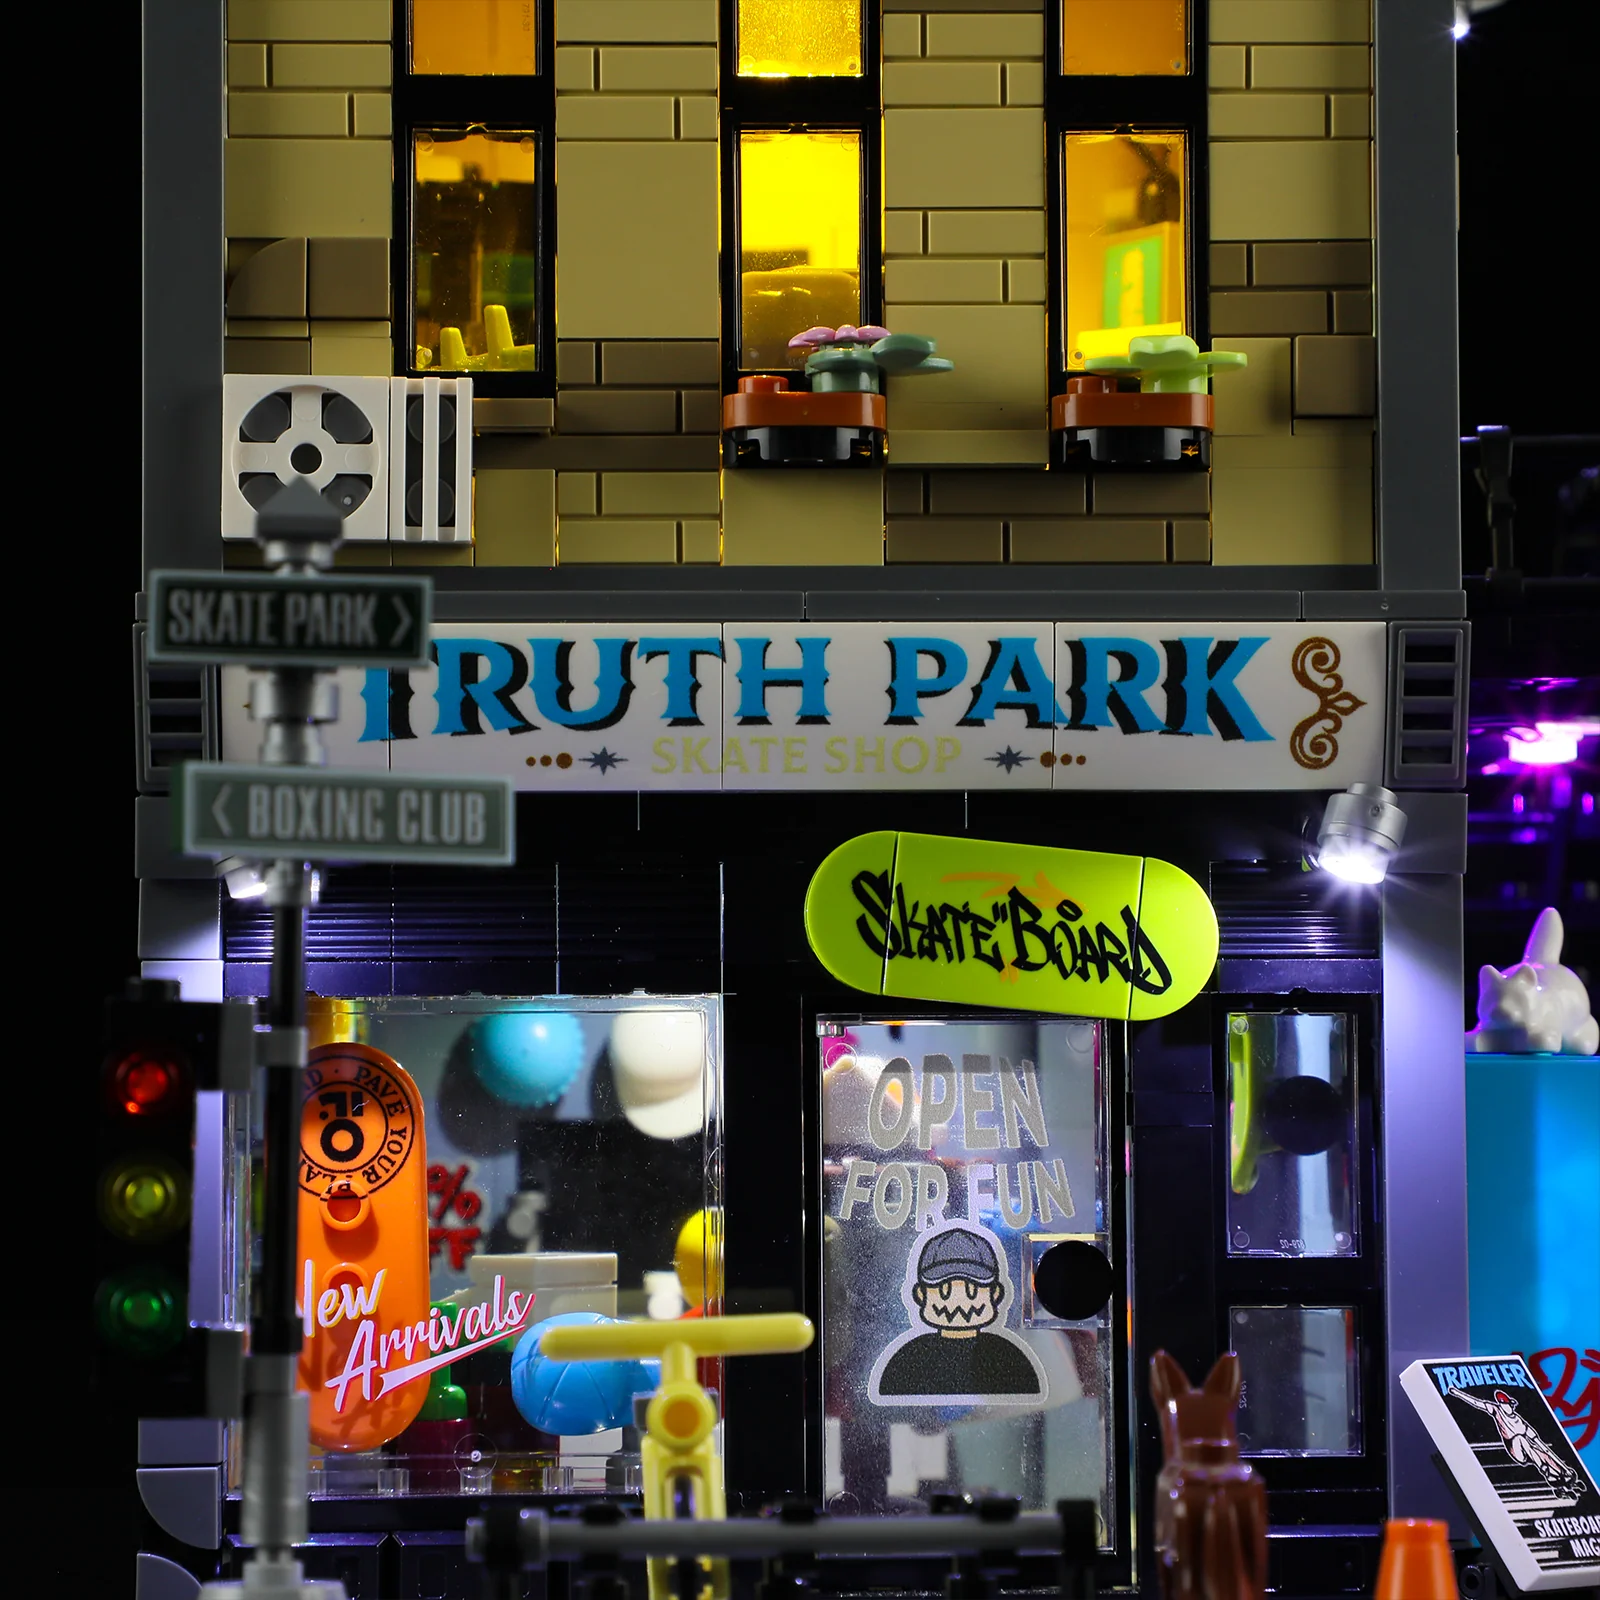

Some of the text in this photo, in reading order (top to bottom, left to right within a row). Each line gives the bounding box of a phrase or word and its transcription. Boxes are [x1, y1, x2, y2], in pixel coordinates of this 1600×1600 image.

[167, 588, 377, 646] SKATE PARK
[883, 637, 1276, 742] PARK
[650, 736, 962, 774] SKATE SHOP
[248, 783, 487, 846] BOXING CLUB
[868, 1053, 1050, 1151] OPEN
[840, 1158, 1076, 1232] FOR FUN
[325, 1274, 536, 1413] Arrivals
[1432, 1363, 1535, 1396] TRAVELER
